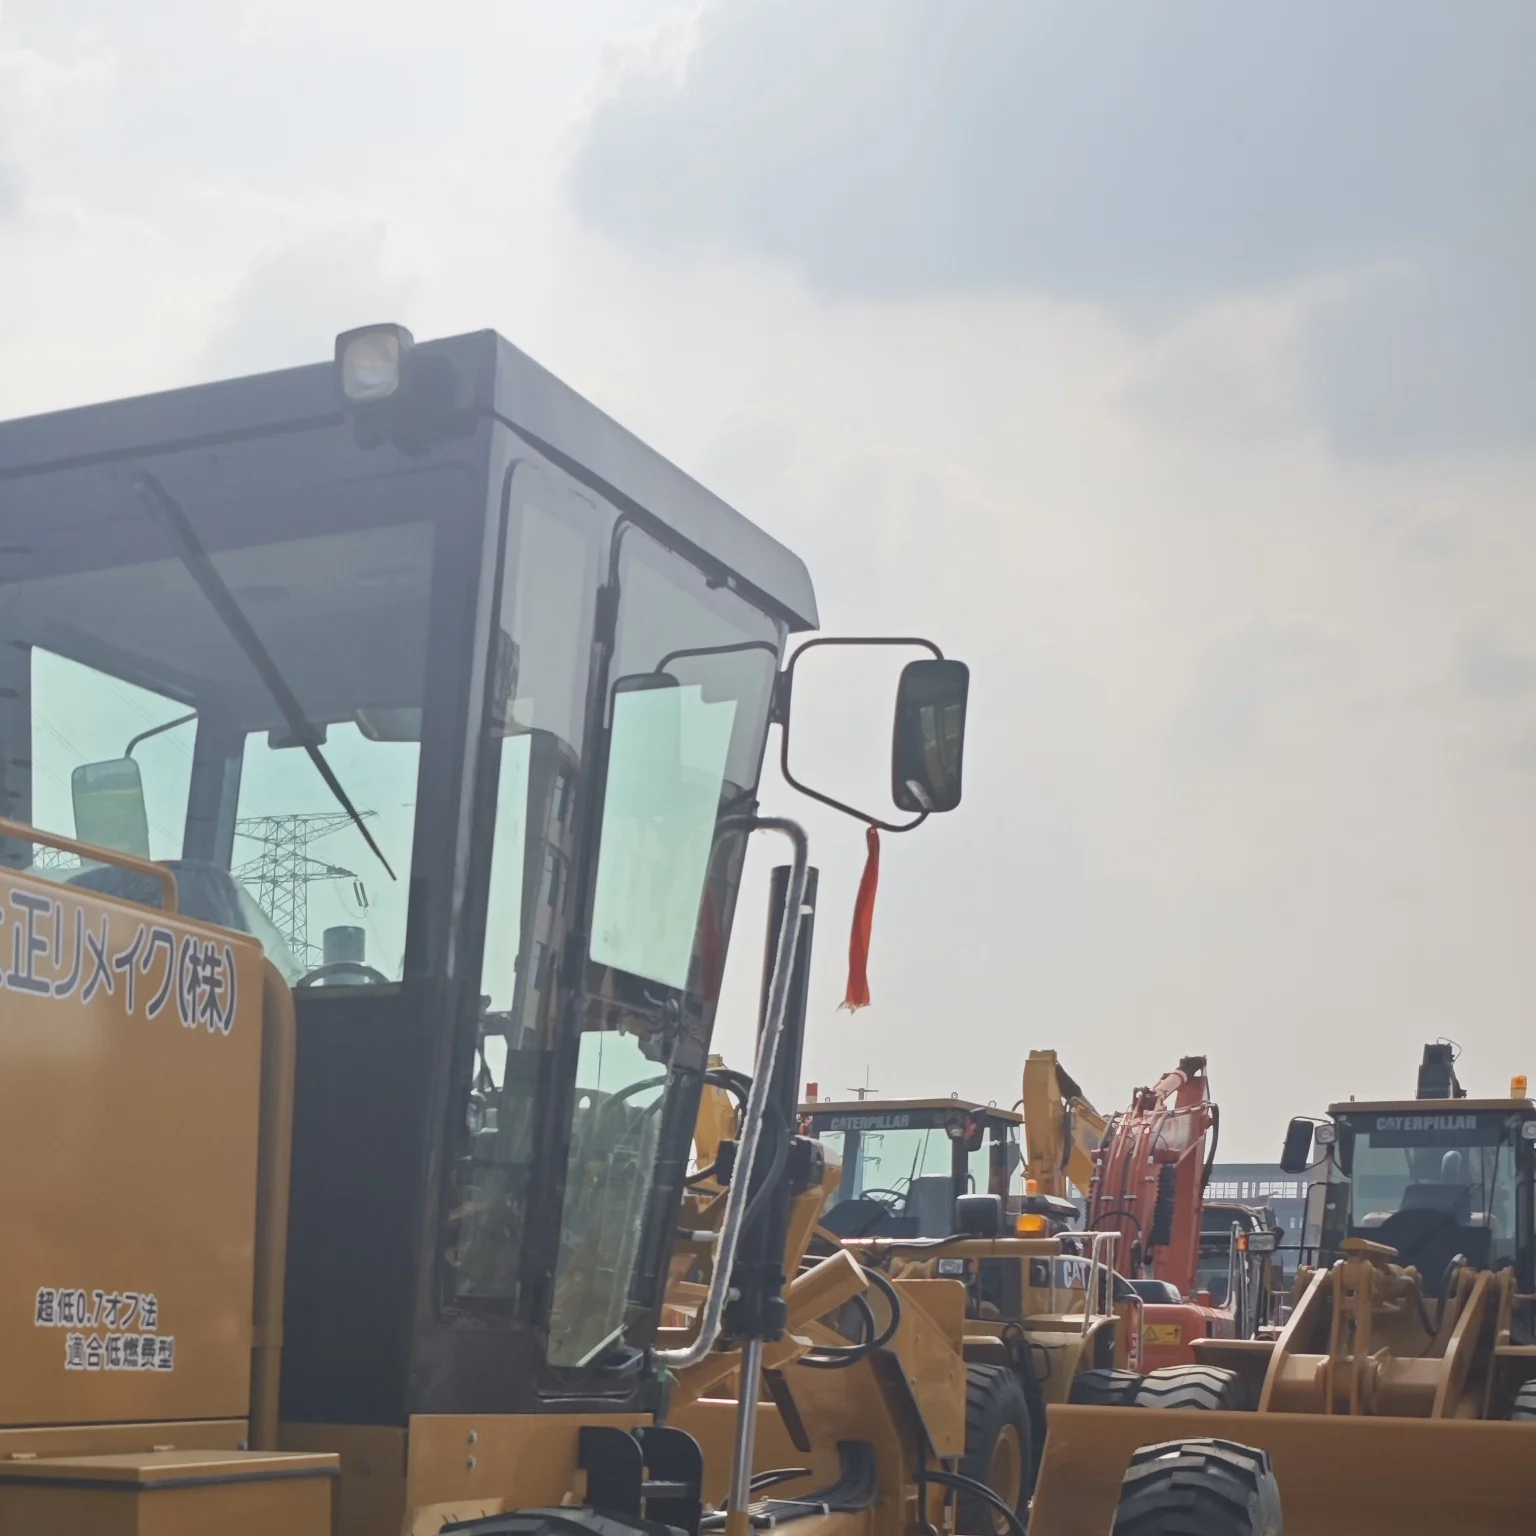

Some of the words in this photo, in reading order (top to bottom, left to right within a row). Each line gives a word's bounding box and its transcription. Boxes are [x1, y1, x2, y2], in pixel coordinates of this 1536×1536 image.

[830, 1114, 910, 1130] CATERPILLAR
[1376, 1115, 1476, 1131] CATERPILLAR
[1064, 1261, 1088, 1289] CAT
